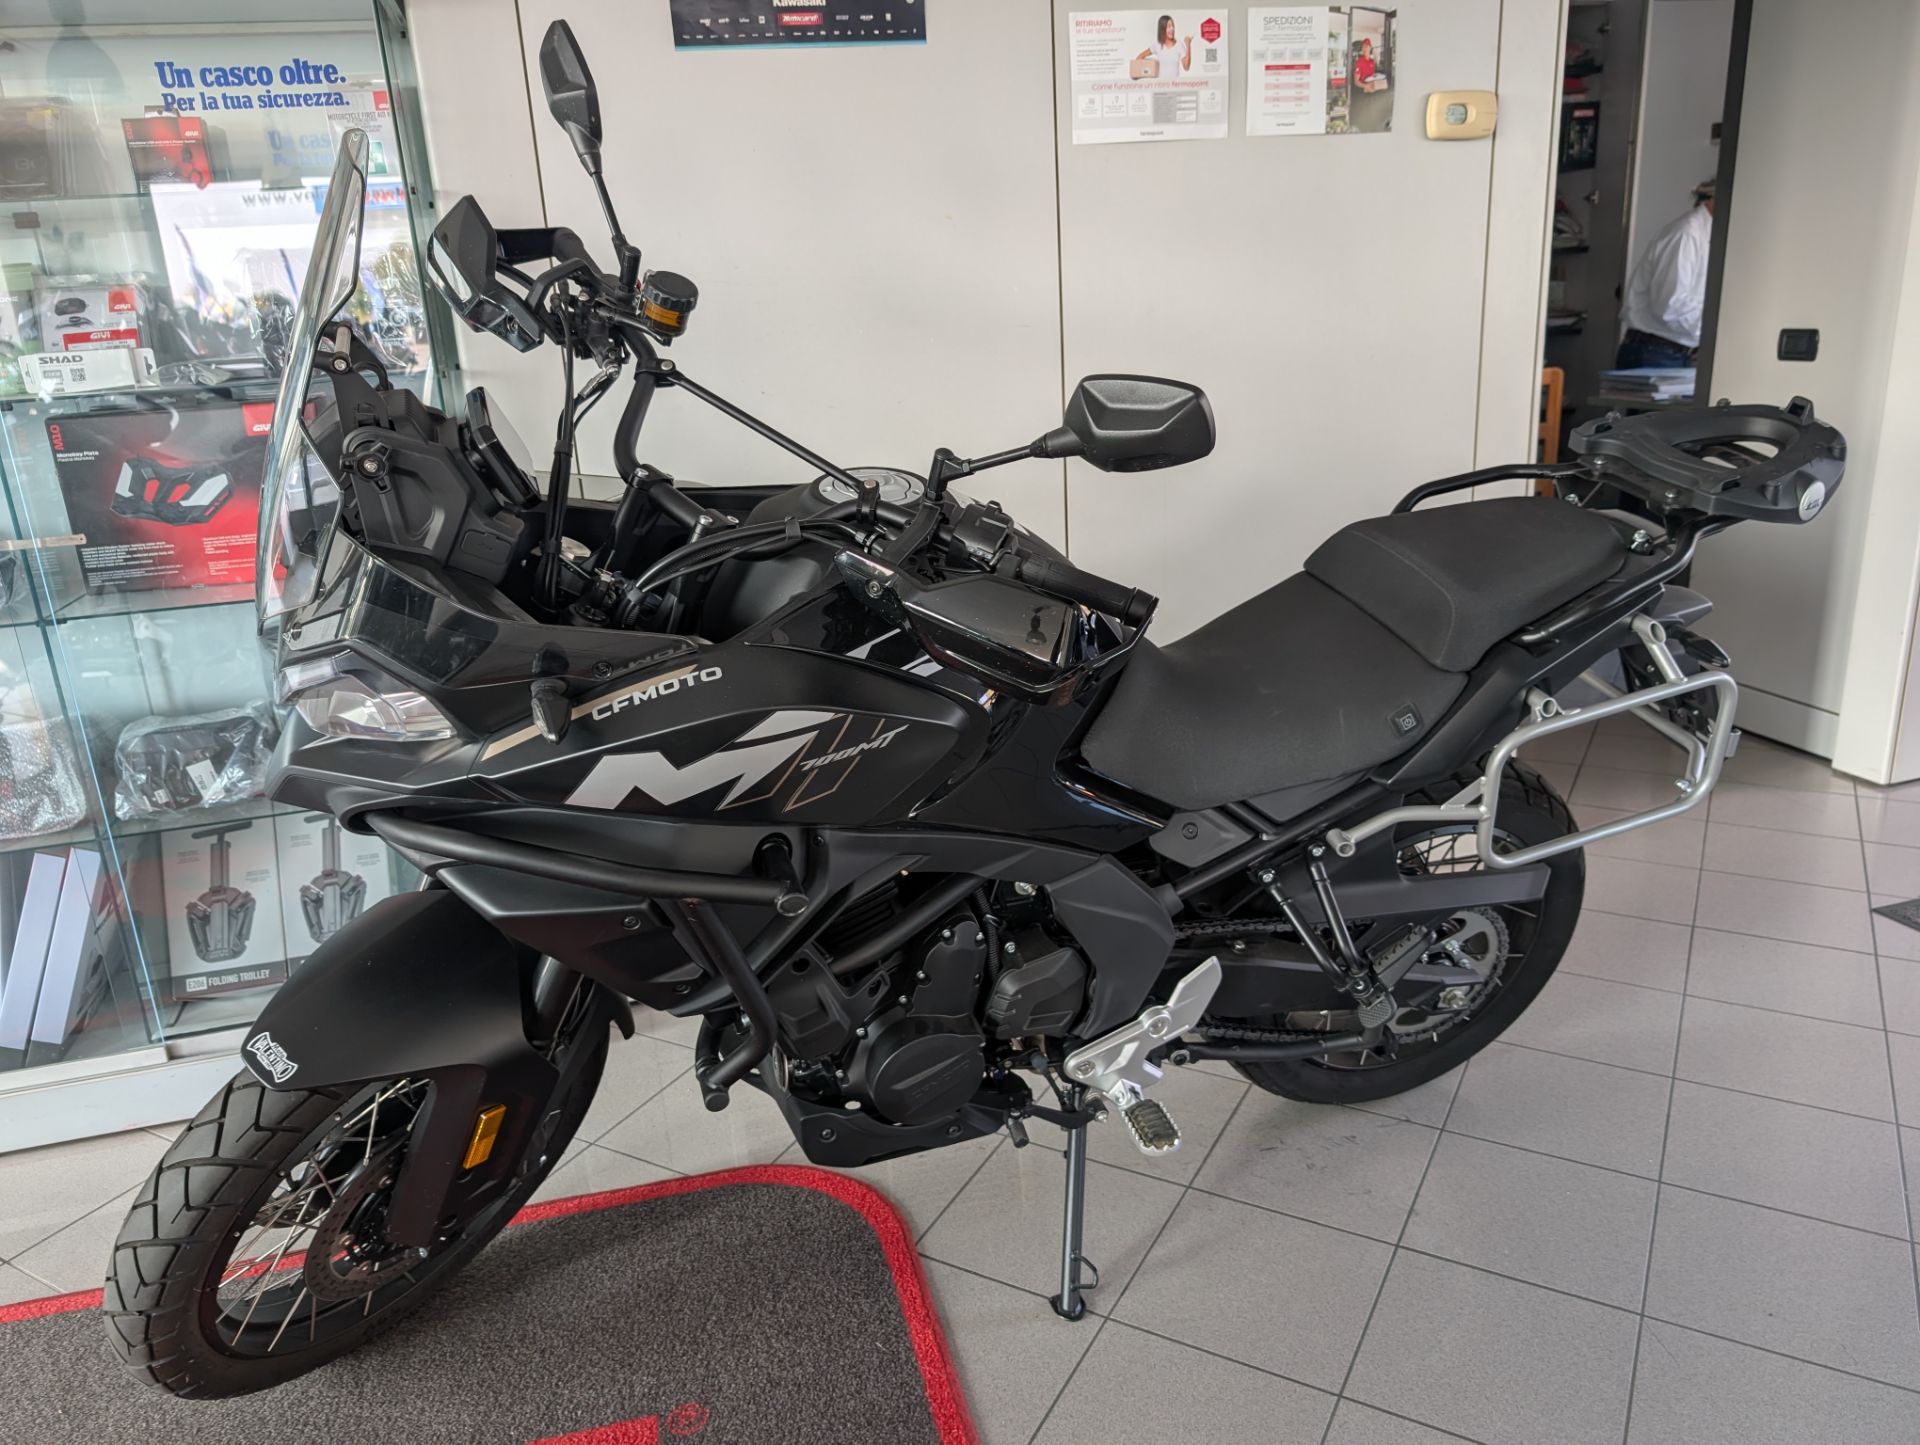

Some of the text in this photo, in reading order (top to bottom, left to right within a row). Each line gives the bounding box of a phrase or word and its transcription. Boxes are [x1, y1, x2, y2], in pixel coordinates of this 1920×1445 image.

[1075, 19, 1112, 28] RITIRIAMO
[1263, 16, 1313, 25] SPEDIZIONI
[154, 58, 347, 89] Un casco oltre.
[1092, 83, 1113, 91] Come
[1171, 80, 1209, 89] fermopoint
[161, 89, 350, 112] Per la tua sicurezza.
[90, 331, 112, 339] GIVI
[38, 354, 84, 365] SHAD
[50, 424, 65, 451] M10
[591, 666, 723, 721] CFMOTO
[799, 724, 910, 772] 700MT
[208, 973, 239, 987] FOLDING
[239, 969, 271, 982] TROLLEY
[253, 1035, 293, 1078] VALENTINO
